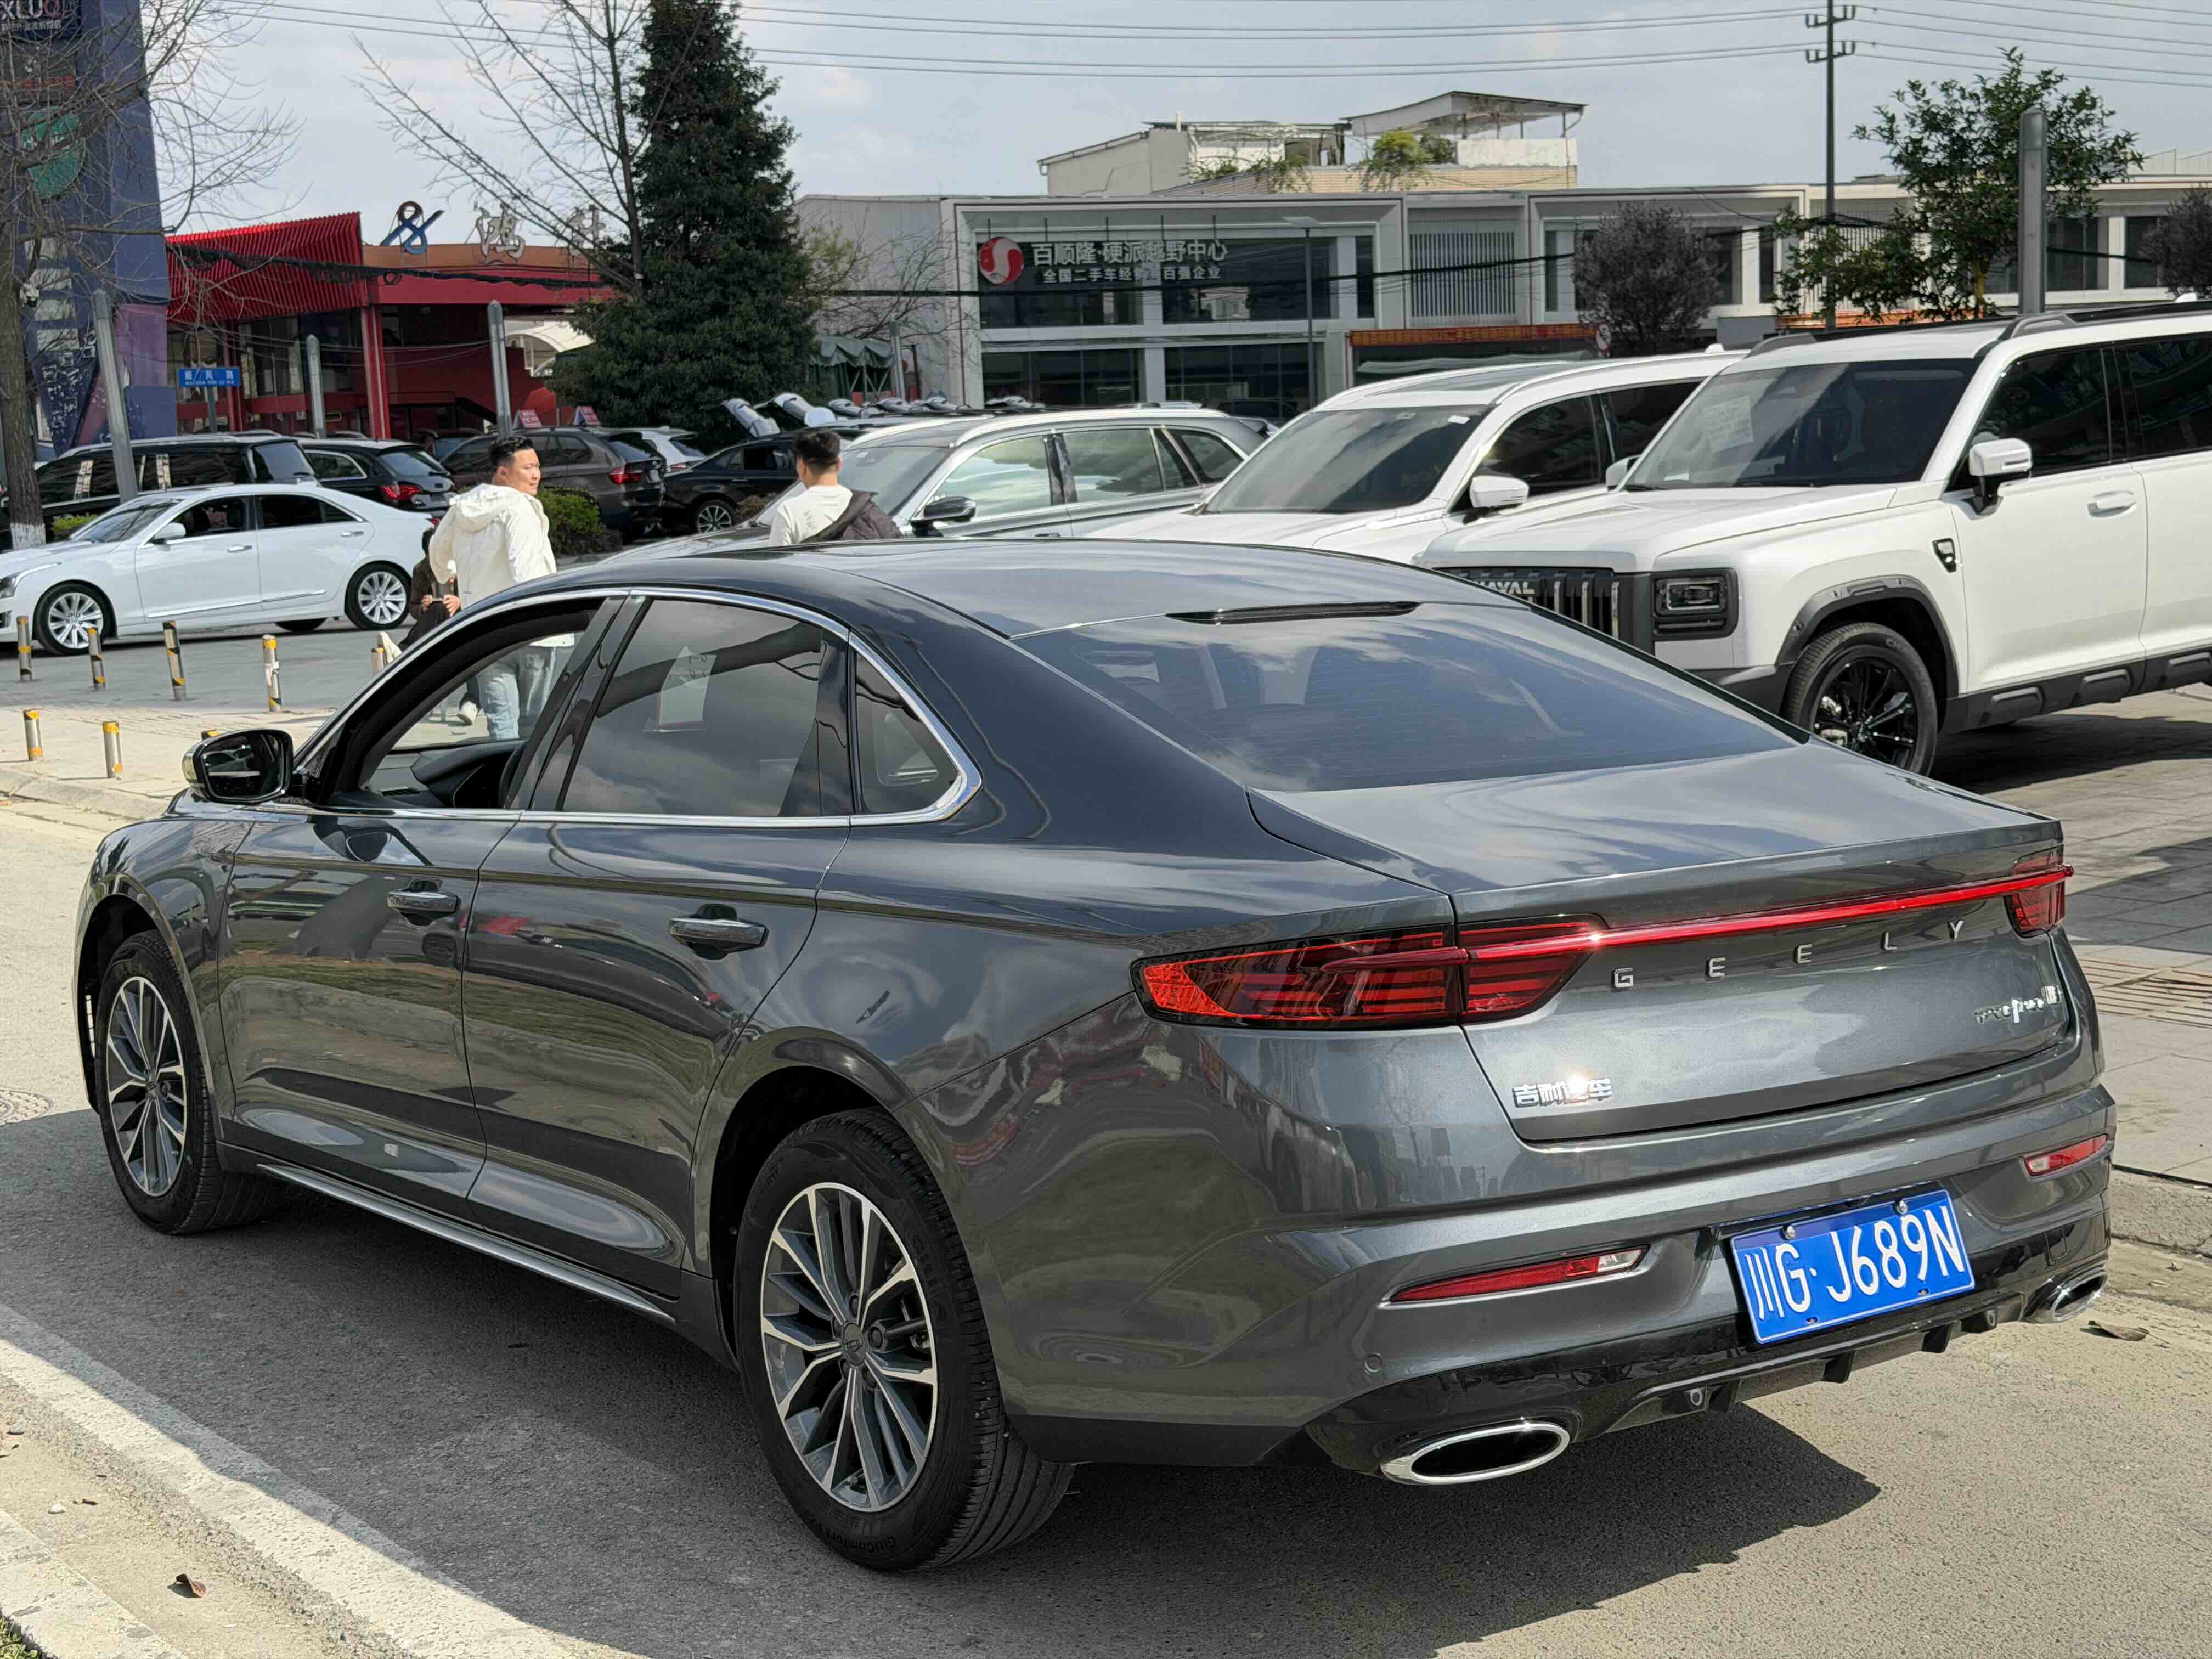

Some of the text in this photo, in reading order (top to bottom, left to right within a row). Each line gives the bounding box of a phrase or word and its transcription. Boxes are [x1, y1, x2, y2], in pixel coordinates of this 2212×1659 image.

[1612, 920, 1965, 989] GEELY
[1512, 1079, 1613, 1108] 吉利车
